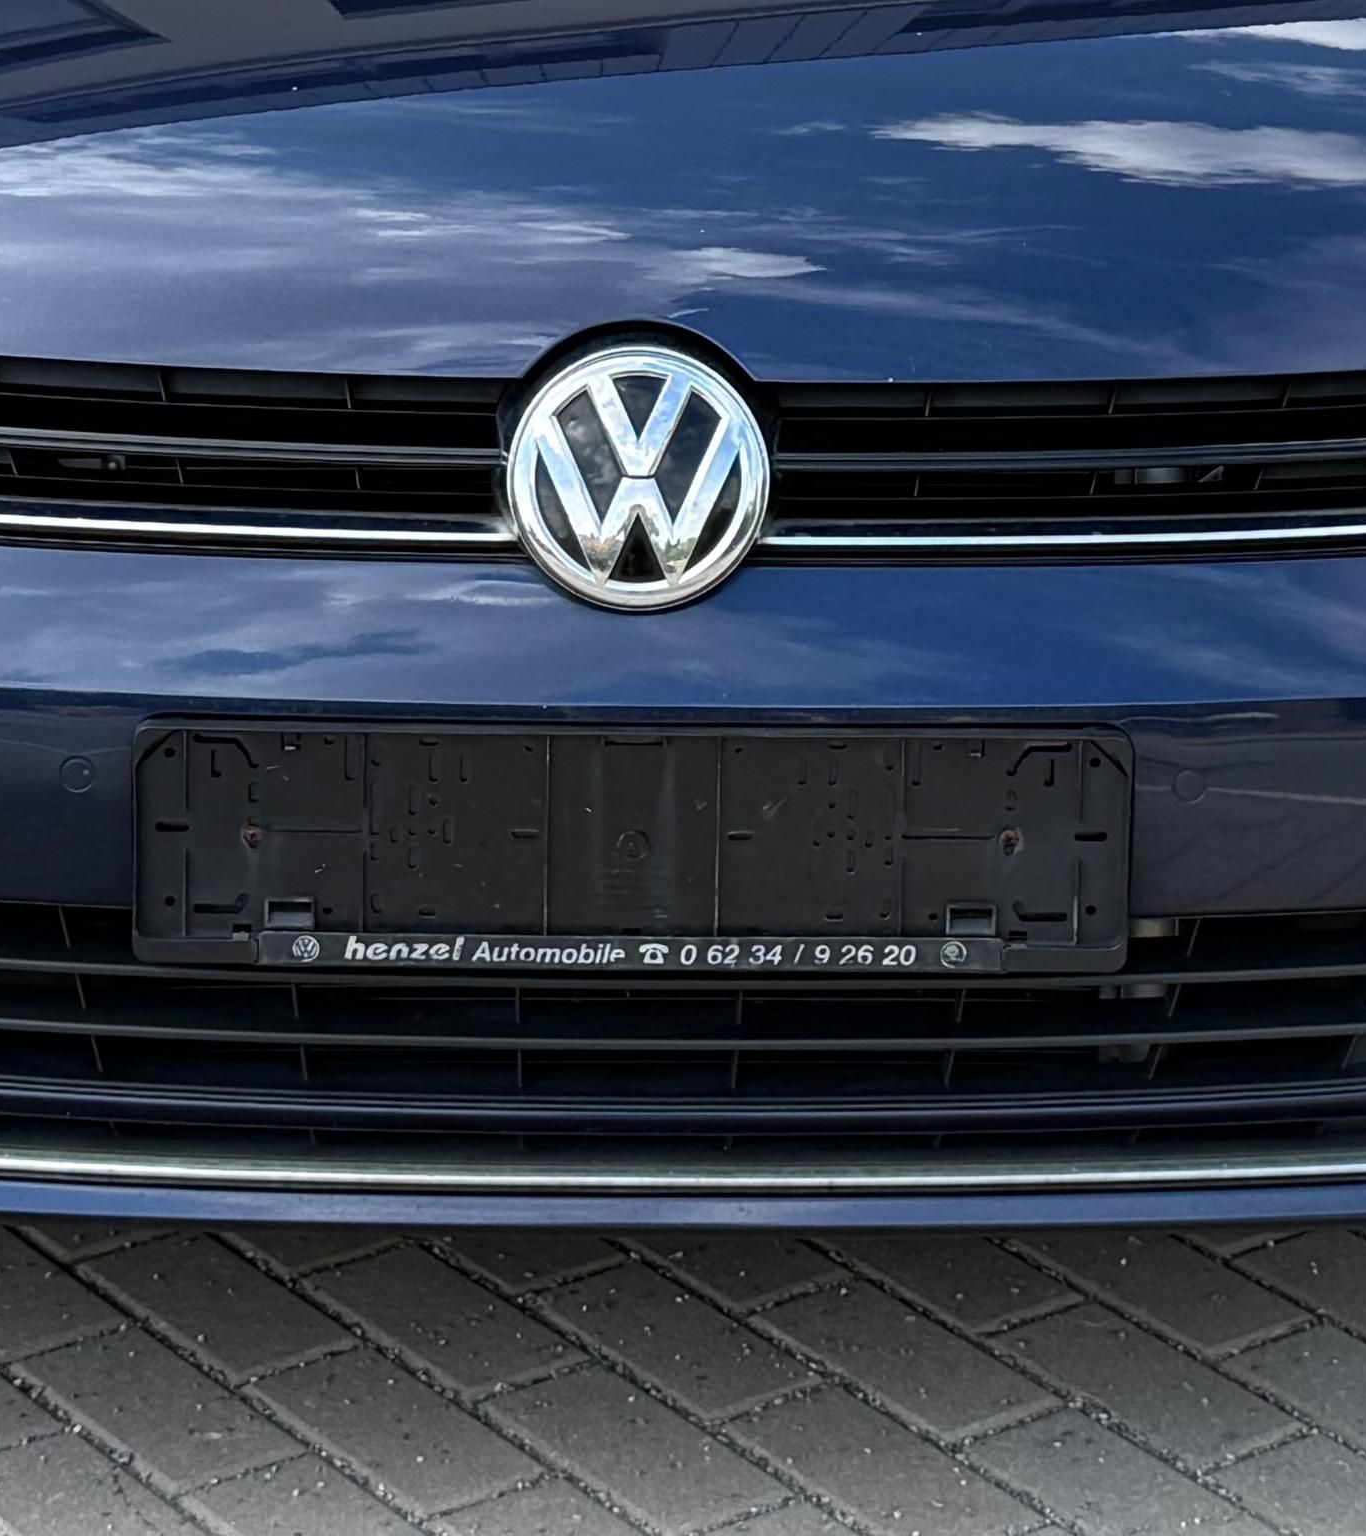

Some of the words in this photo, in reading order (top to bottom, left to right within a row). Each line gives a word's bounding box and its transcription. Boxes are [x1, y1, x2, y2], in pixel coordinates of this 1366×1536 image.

[530, 364, 747, 591] VW
[344, 935, 466, 961] henzel
[472, 941, 626, 964] Automobile
[680, 944, 697, 965] 0
[706, 944, 740, 965] 62
[748, 944, 783, 965] 34
[814, 944, 831, 965] 9
[839, 944, 875, 965] 26
[882, 944, 917, 965] 20
